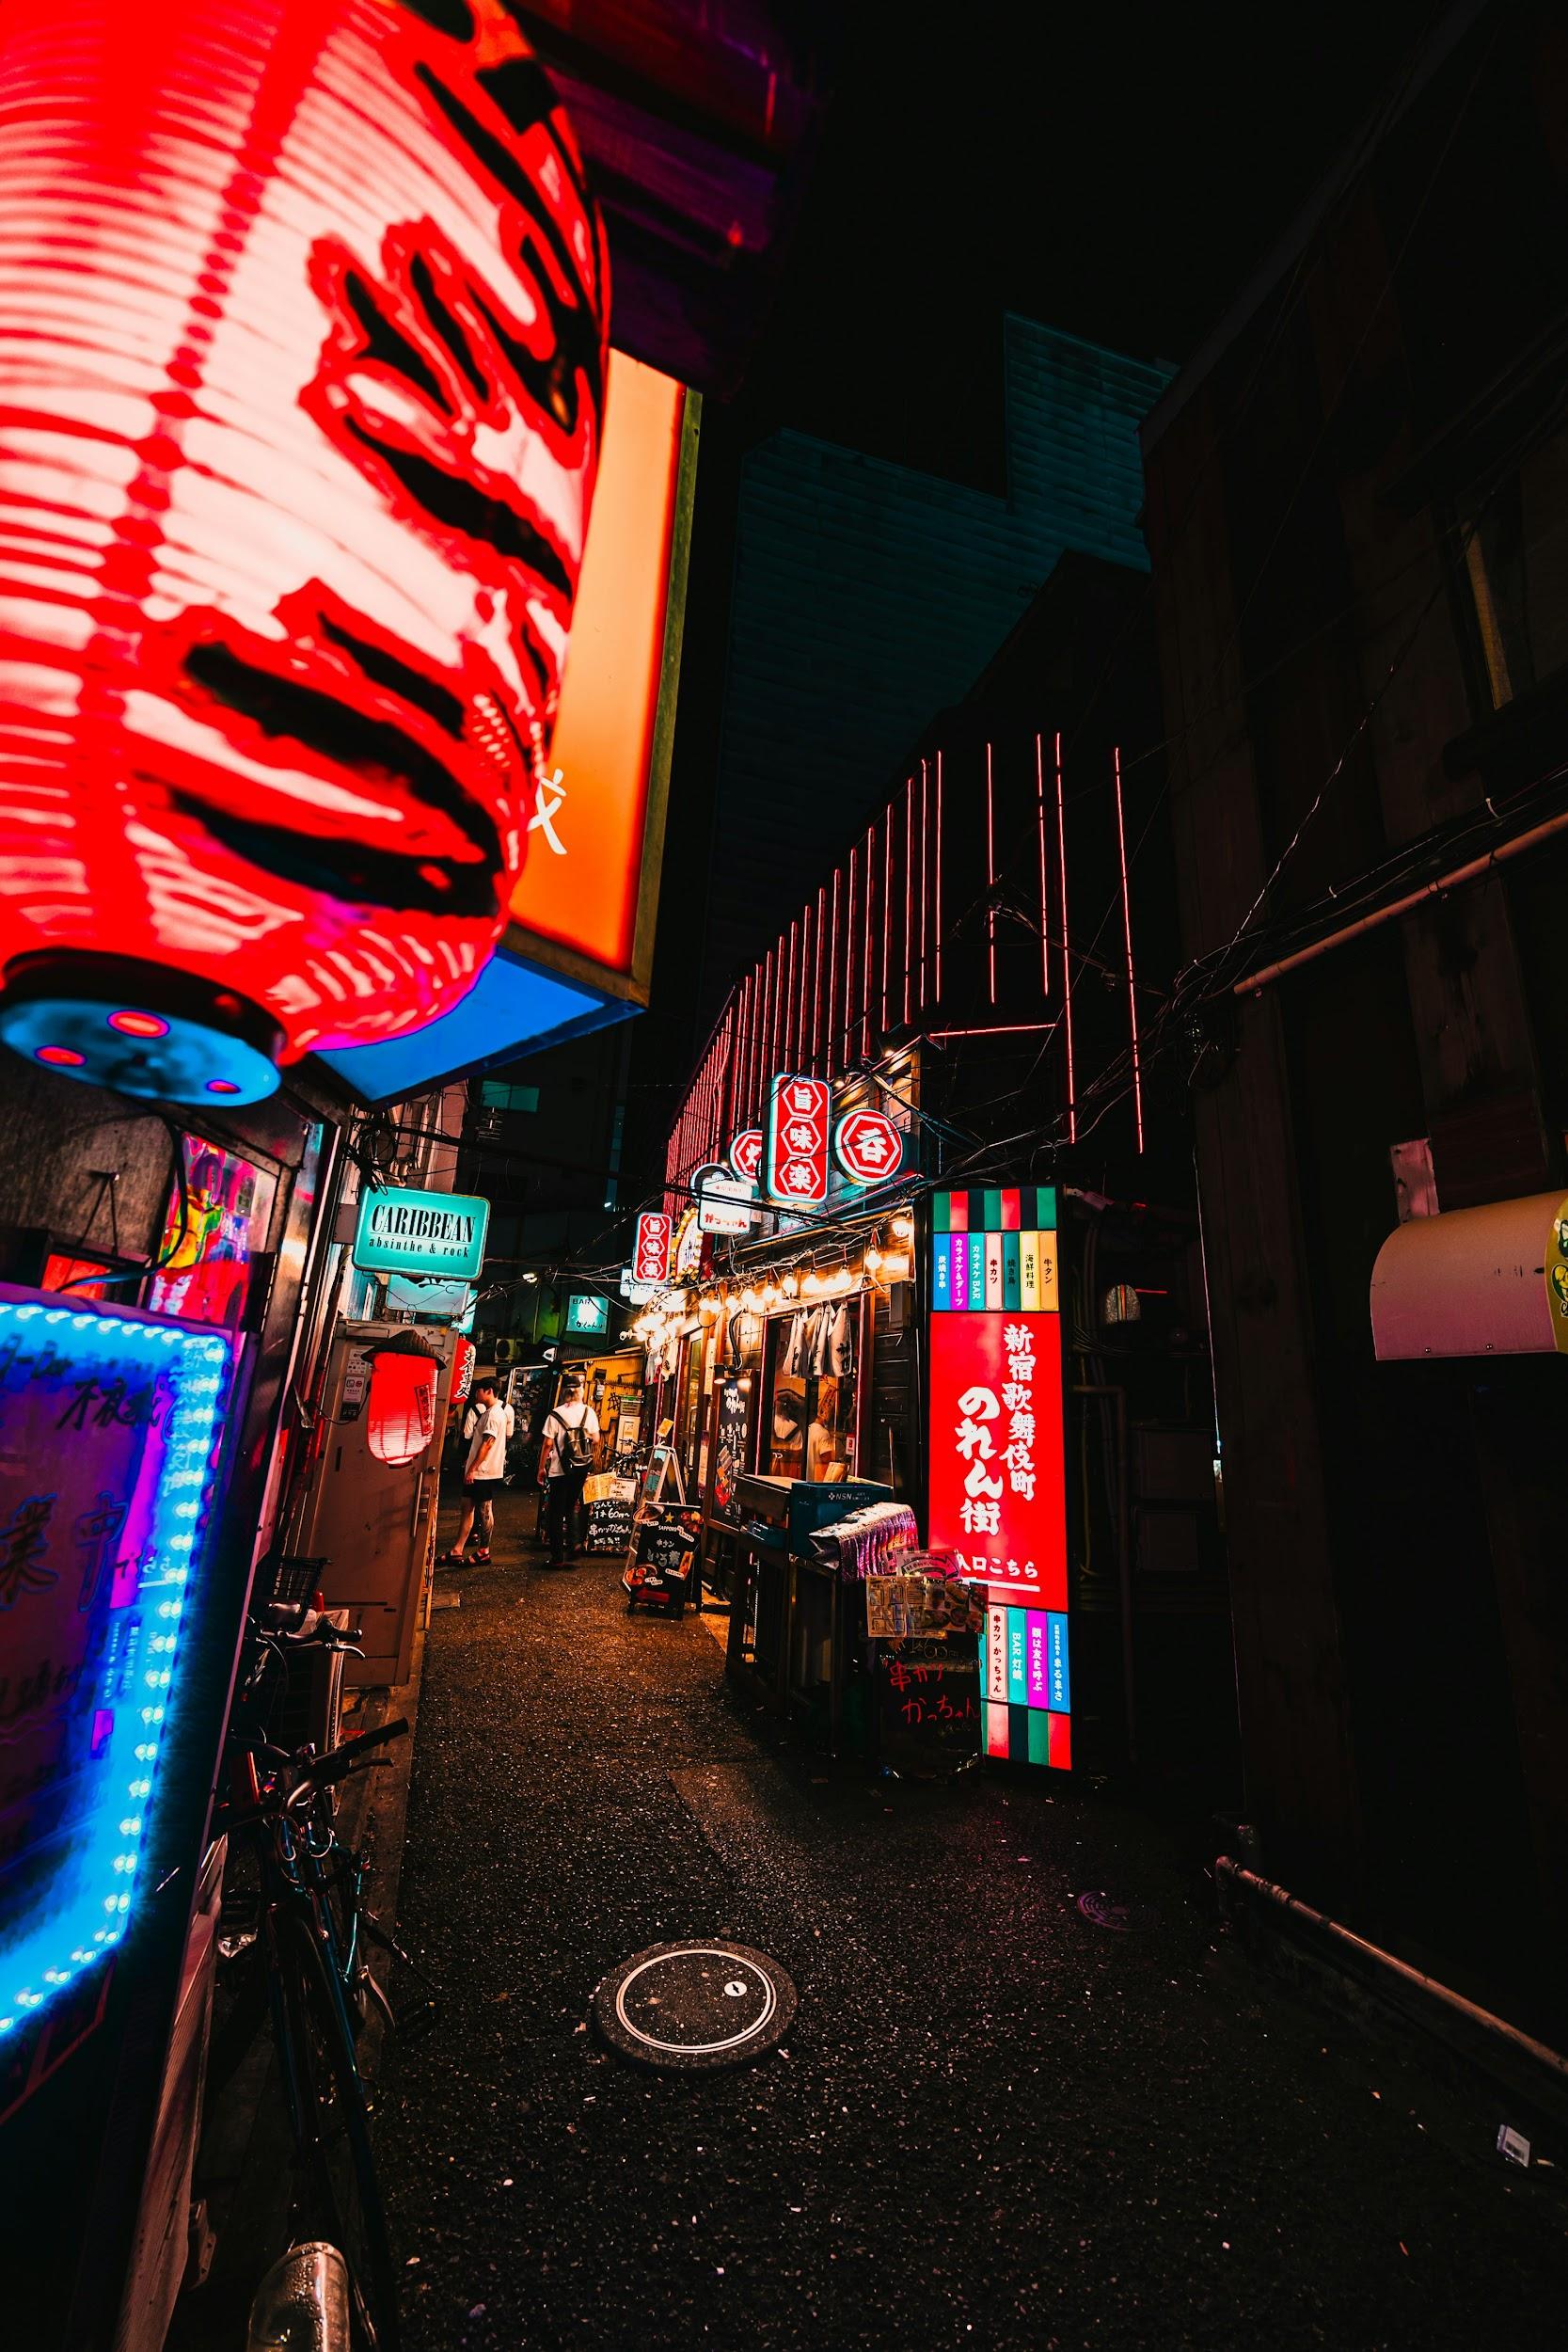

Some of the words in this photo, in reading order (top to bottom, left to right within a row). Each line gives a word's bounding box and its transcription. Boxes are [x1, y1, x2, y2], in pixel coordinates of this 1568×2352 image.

[788, 1087, 814, 1191] 旨味楽
[854, 1127, 889, 1164] 呑
[372, 1204, 476, 1243] CARIBBEAN
[705, 1214, 748, 1228] かっん
[369, 1237, 422, 1252] absinthe
[429, 1244, 436, 1254] &
[443, 1246, 469, 1258] rock
[972, 1244, 981, 1279] カラオケ
[1025, 1253, 1036, 1289] 海鮮料理
[1043, 1258, 1053, 1284] 牛タン
[972, 1279, 981, 1300] BAR
[999, 1323, 1037, 1501] 新宿歌舞伎町
[955, 1385, 1003, 1535] のれん街
[958, 1553, 1038, 1579] 入口こちら
[993, 1614, 1002, 1642] 串カツ
[1012, 1632, 1022, 1656] BAR
[993, 1646, 1002, 1693] かっちゃん
